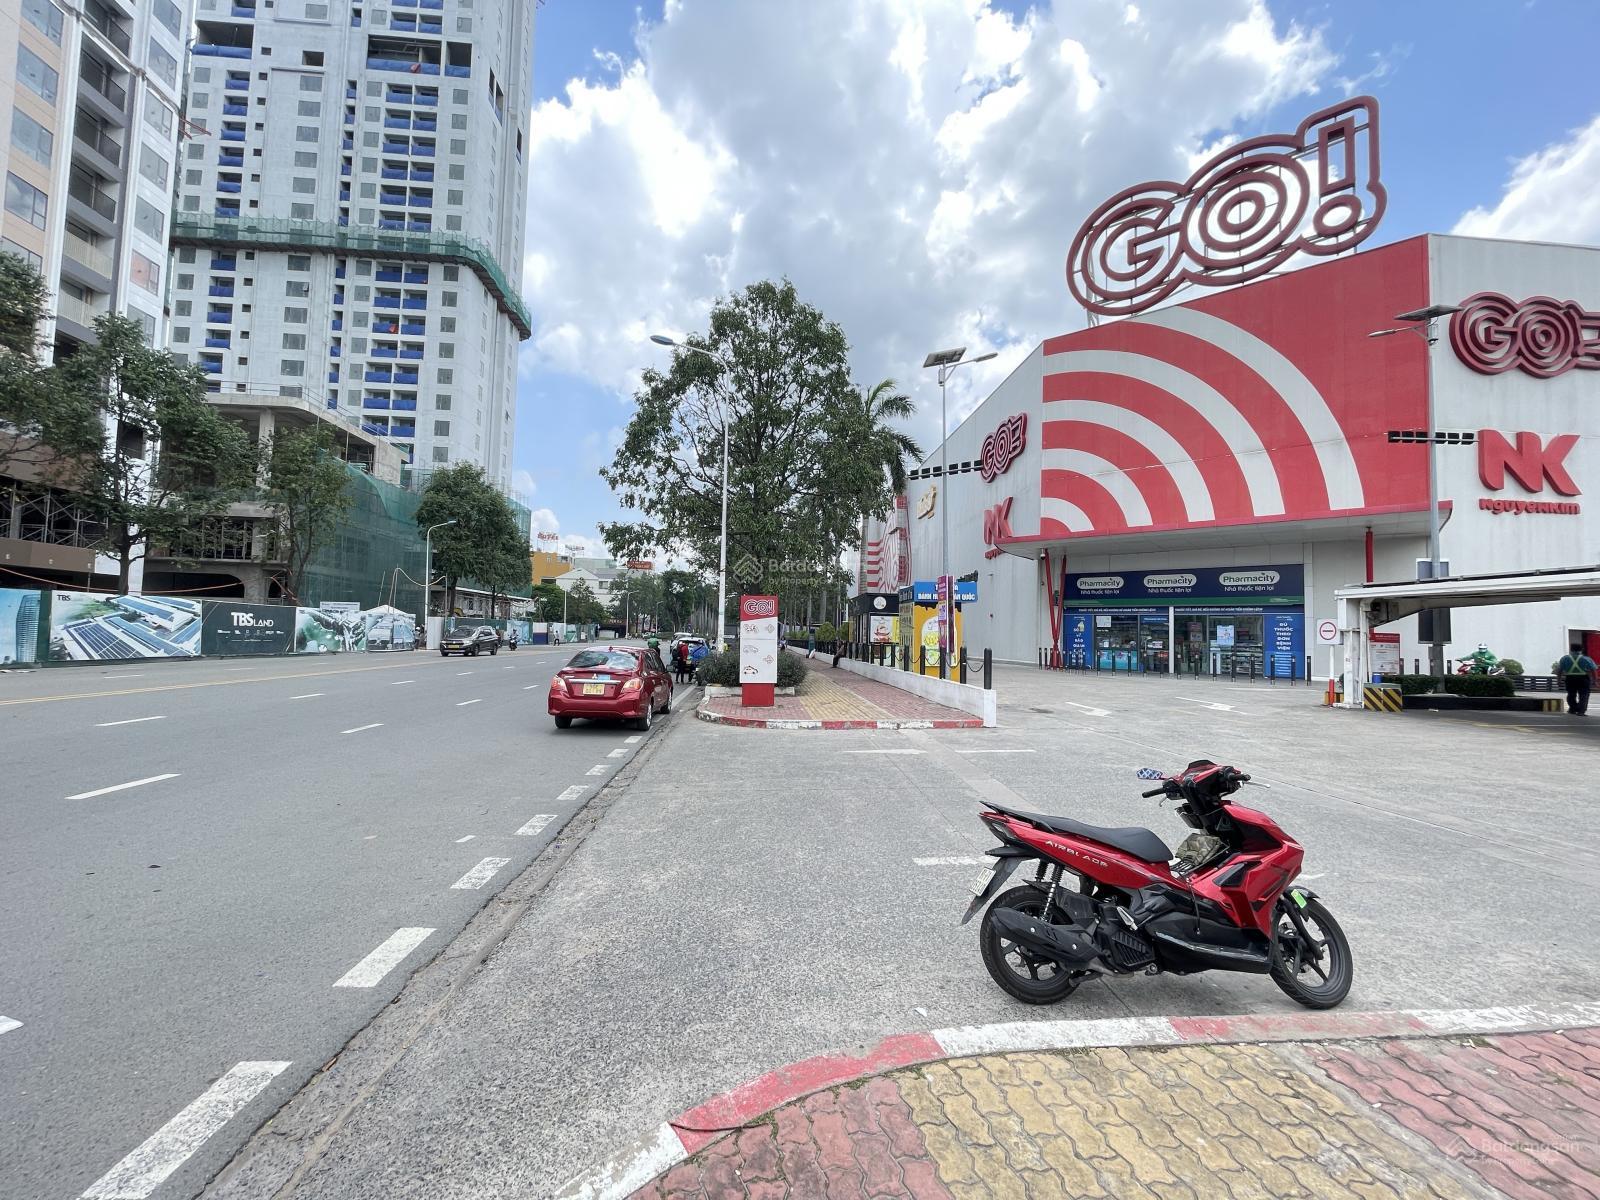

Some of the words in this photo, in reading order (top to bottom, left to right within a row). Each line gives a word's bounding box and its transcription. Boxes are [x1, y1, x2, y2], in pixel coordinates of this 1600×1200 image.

[1066, 96, 1387, 316] GO!
[1478, 429, 1582, 496] NK
[1079, 578, 1120, 588] Pharmacity
[1147, 577, 1193, 586] Pharmacity
[1223, 574, 1275, 583] Pharmacity
[744, 599, 774, 615] GO!
[231, 612, 254, 627] TBS
[254, 619, 274, 627] LAND
